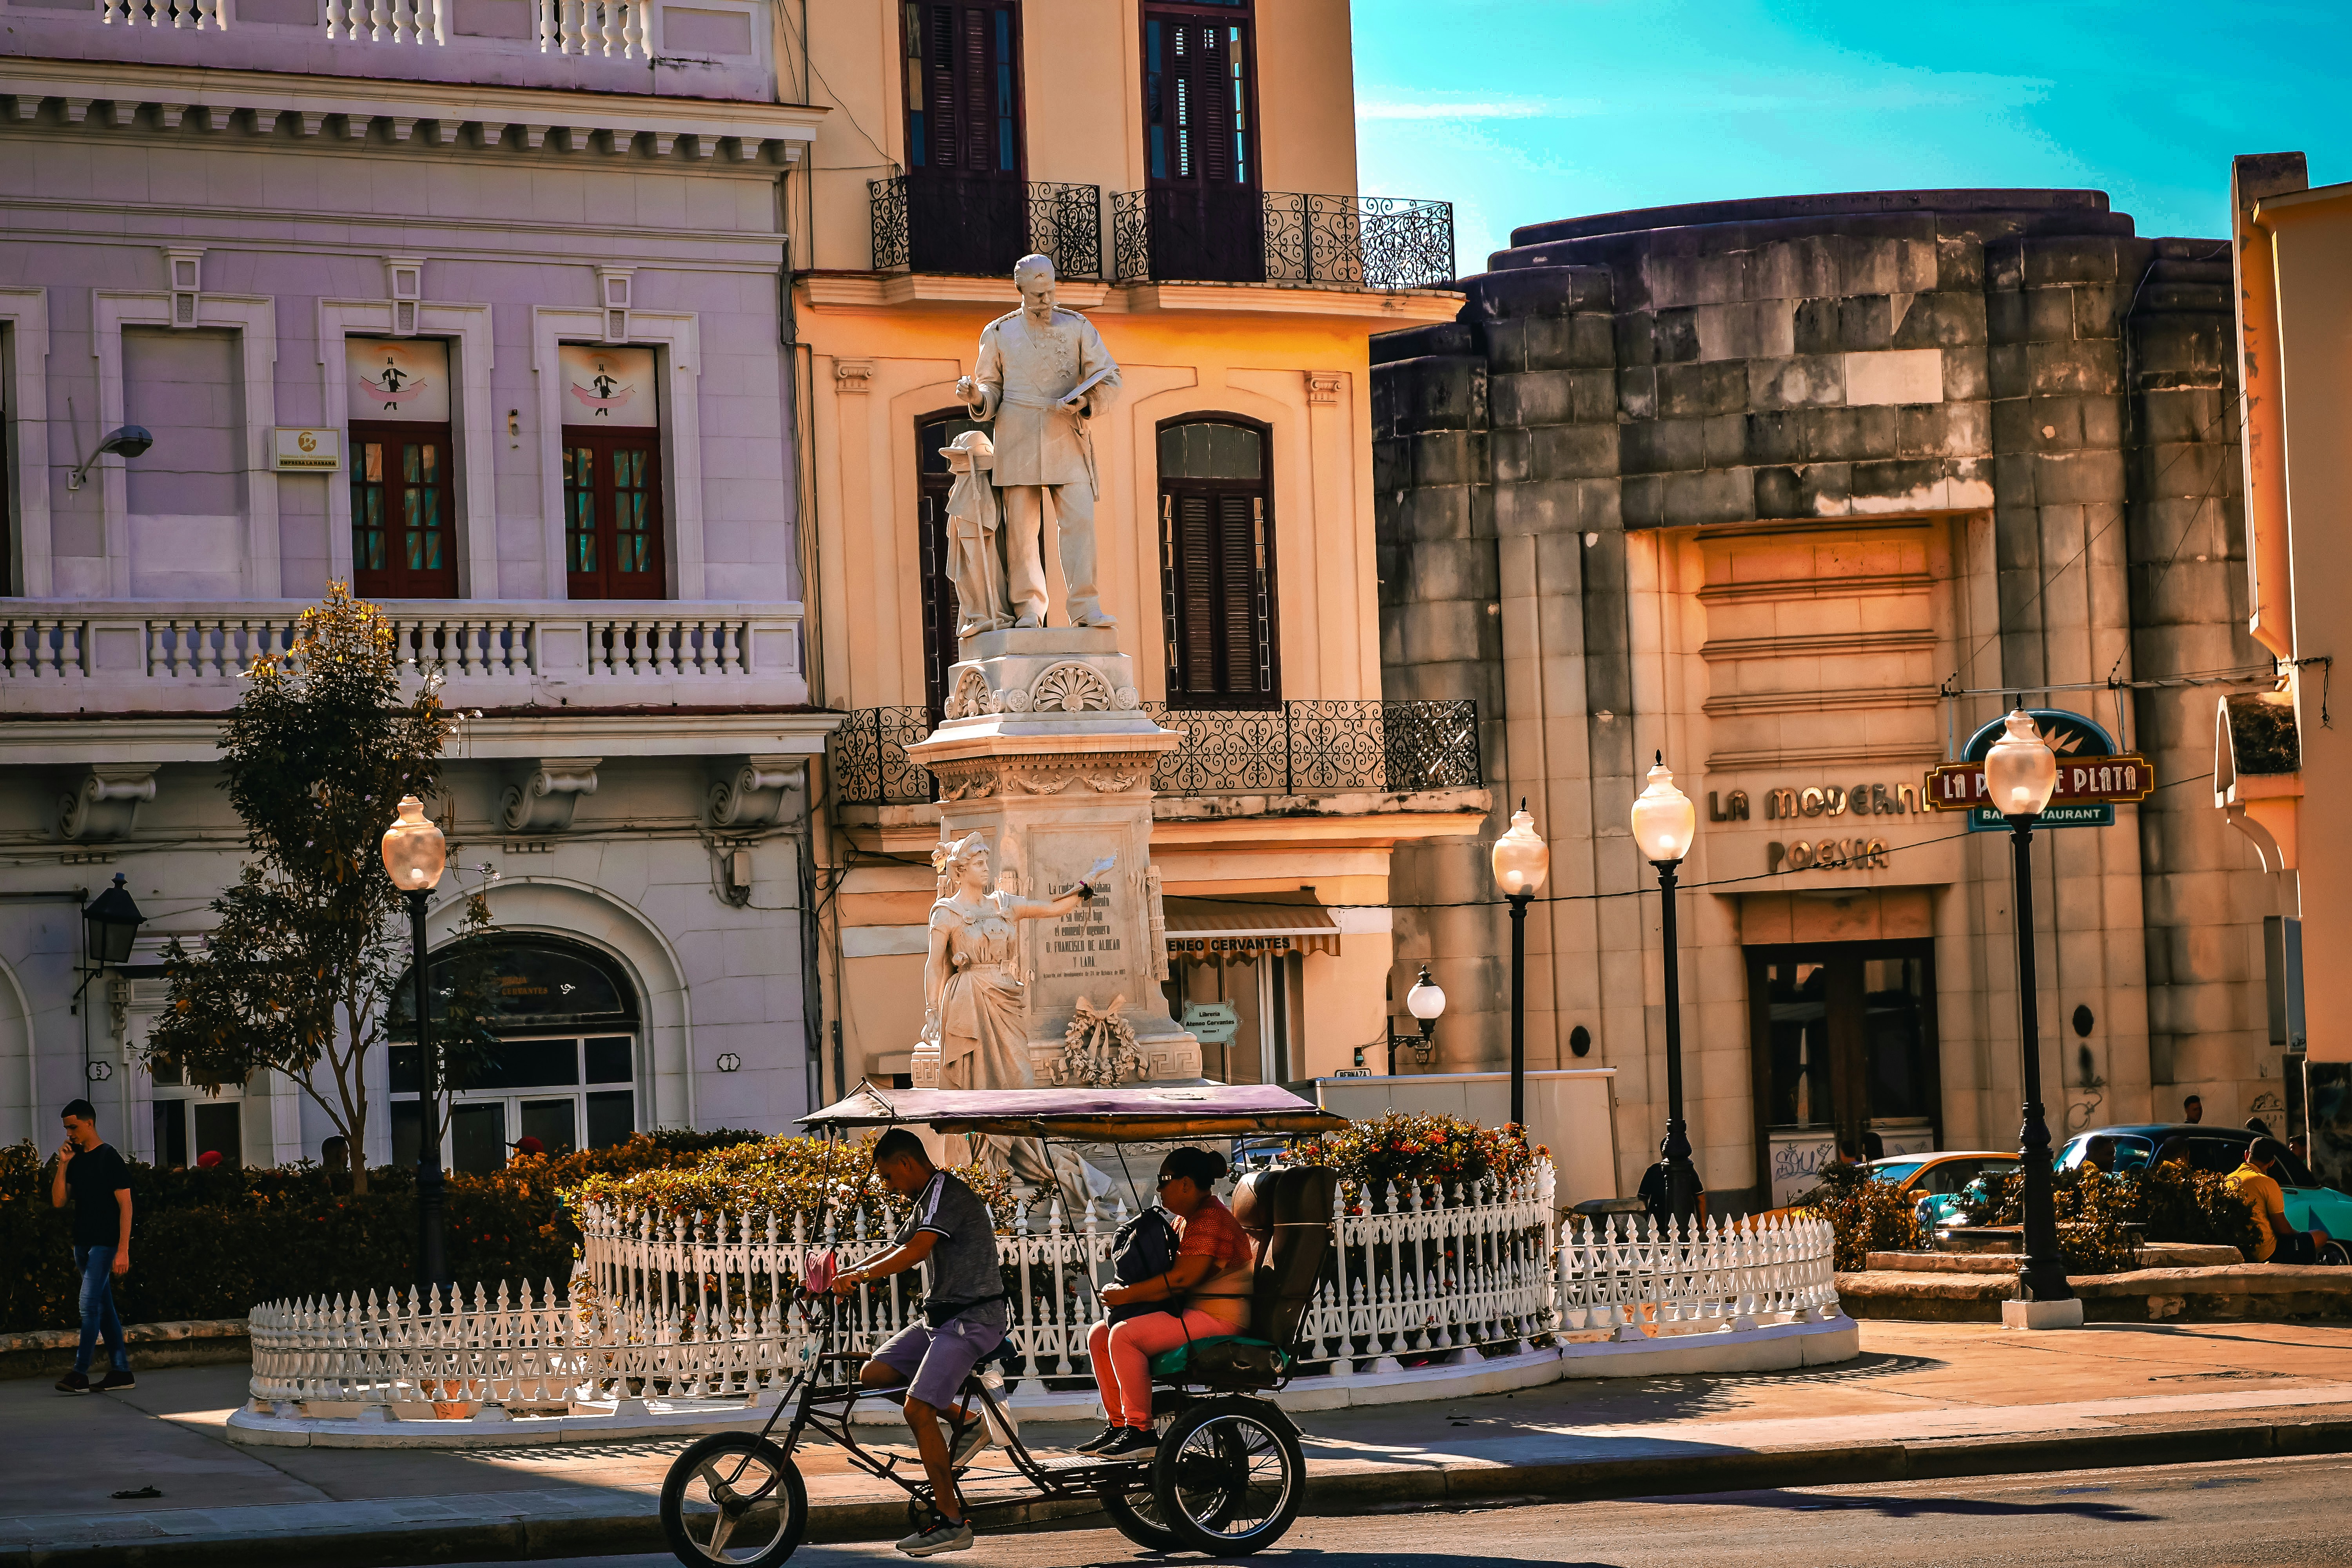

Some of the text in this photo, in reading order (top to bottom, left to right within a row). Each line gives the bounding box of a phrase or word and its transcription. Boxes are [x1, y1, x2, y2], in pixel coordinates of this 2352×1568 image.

[1944, 773, 1965, 798] LA
[2074, 766, 2136, 792] PLATA
[1709, 789, 1750, 822] LA
[2041, 809, 2101, 819] TAURANT
[1768, 837, 1889, 873] POESIA
[1049, 883, 1056, 895] La
[1054, 940, 1085, 953] FRANCISCO
[1088, 940, 1096, 951] DE
[1168, 937, 1290, 951] ENEO CERVANTES
[1073, 956, 1077, 968] Y
[502, 987, 548, 996] CERVANTES
[726, 1057, 731, 1069] 7
[96, 1065, 102, 1076] 5
